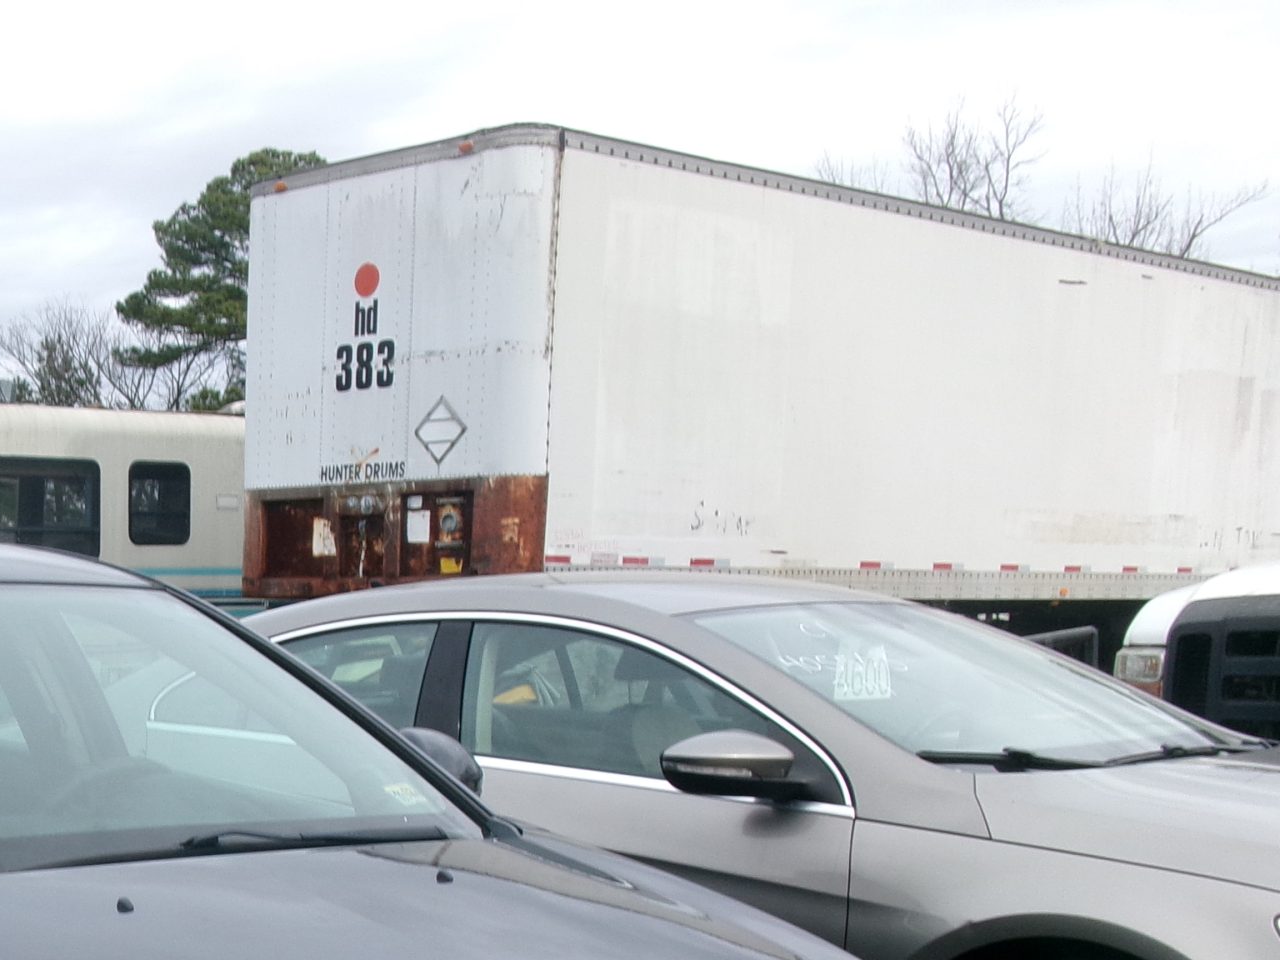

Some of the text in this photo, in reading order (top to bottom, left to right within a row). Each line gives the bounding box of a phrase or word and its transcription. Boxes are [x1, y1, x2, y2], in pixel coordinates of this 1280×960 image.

[335, 339, 395, 392] 383
[321, 461, 406, 482] HUNTER DRUMS
